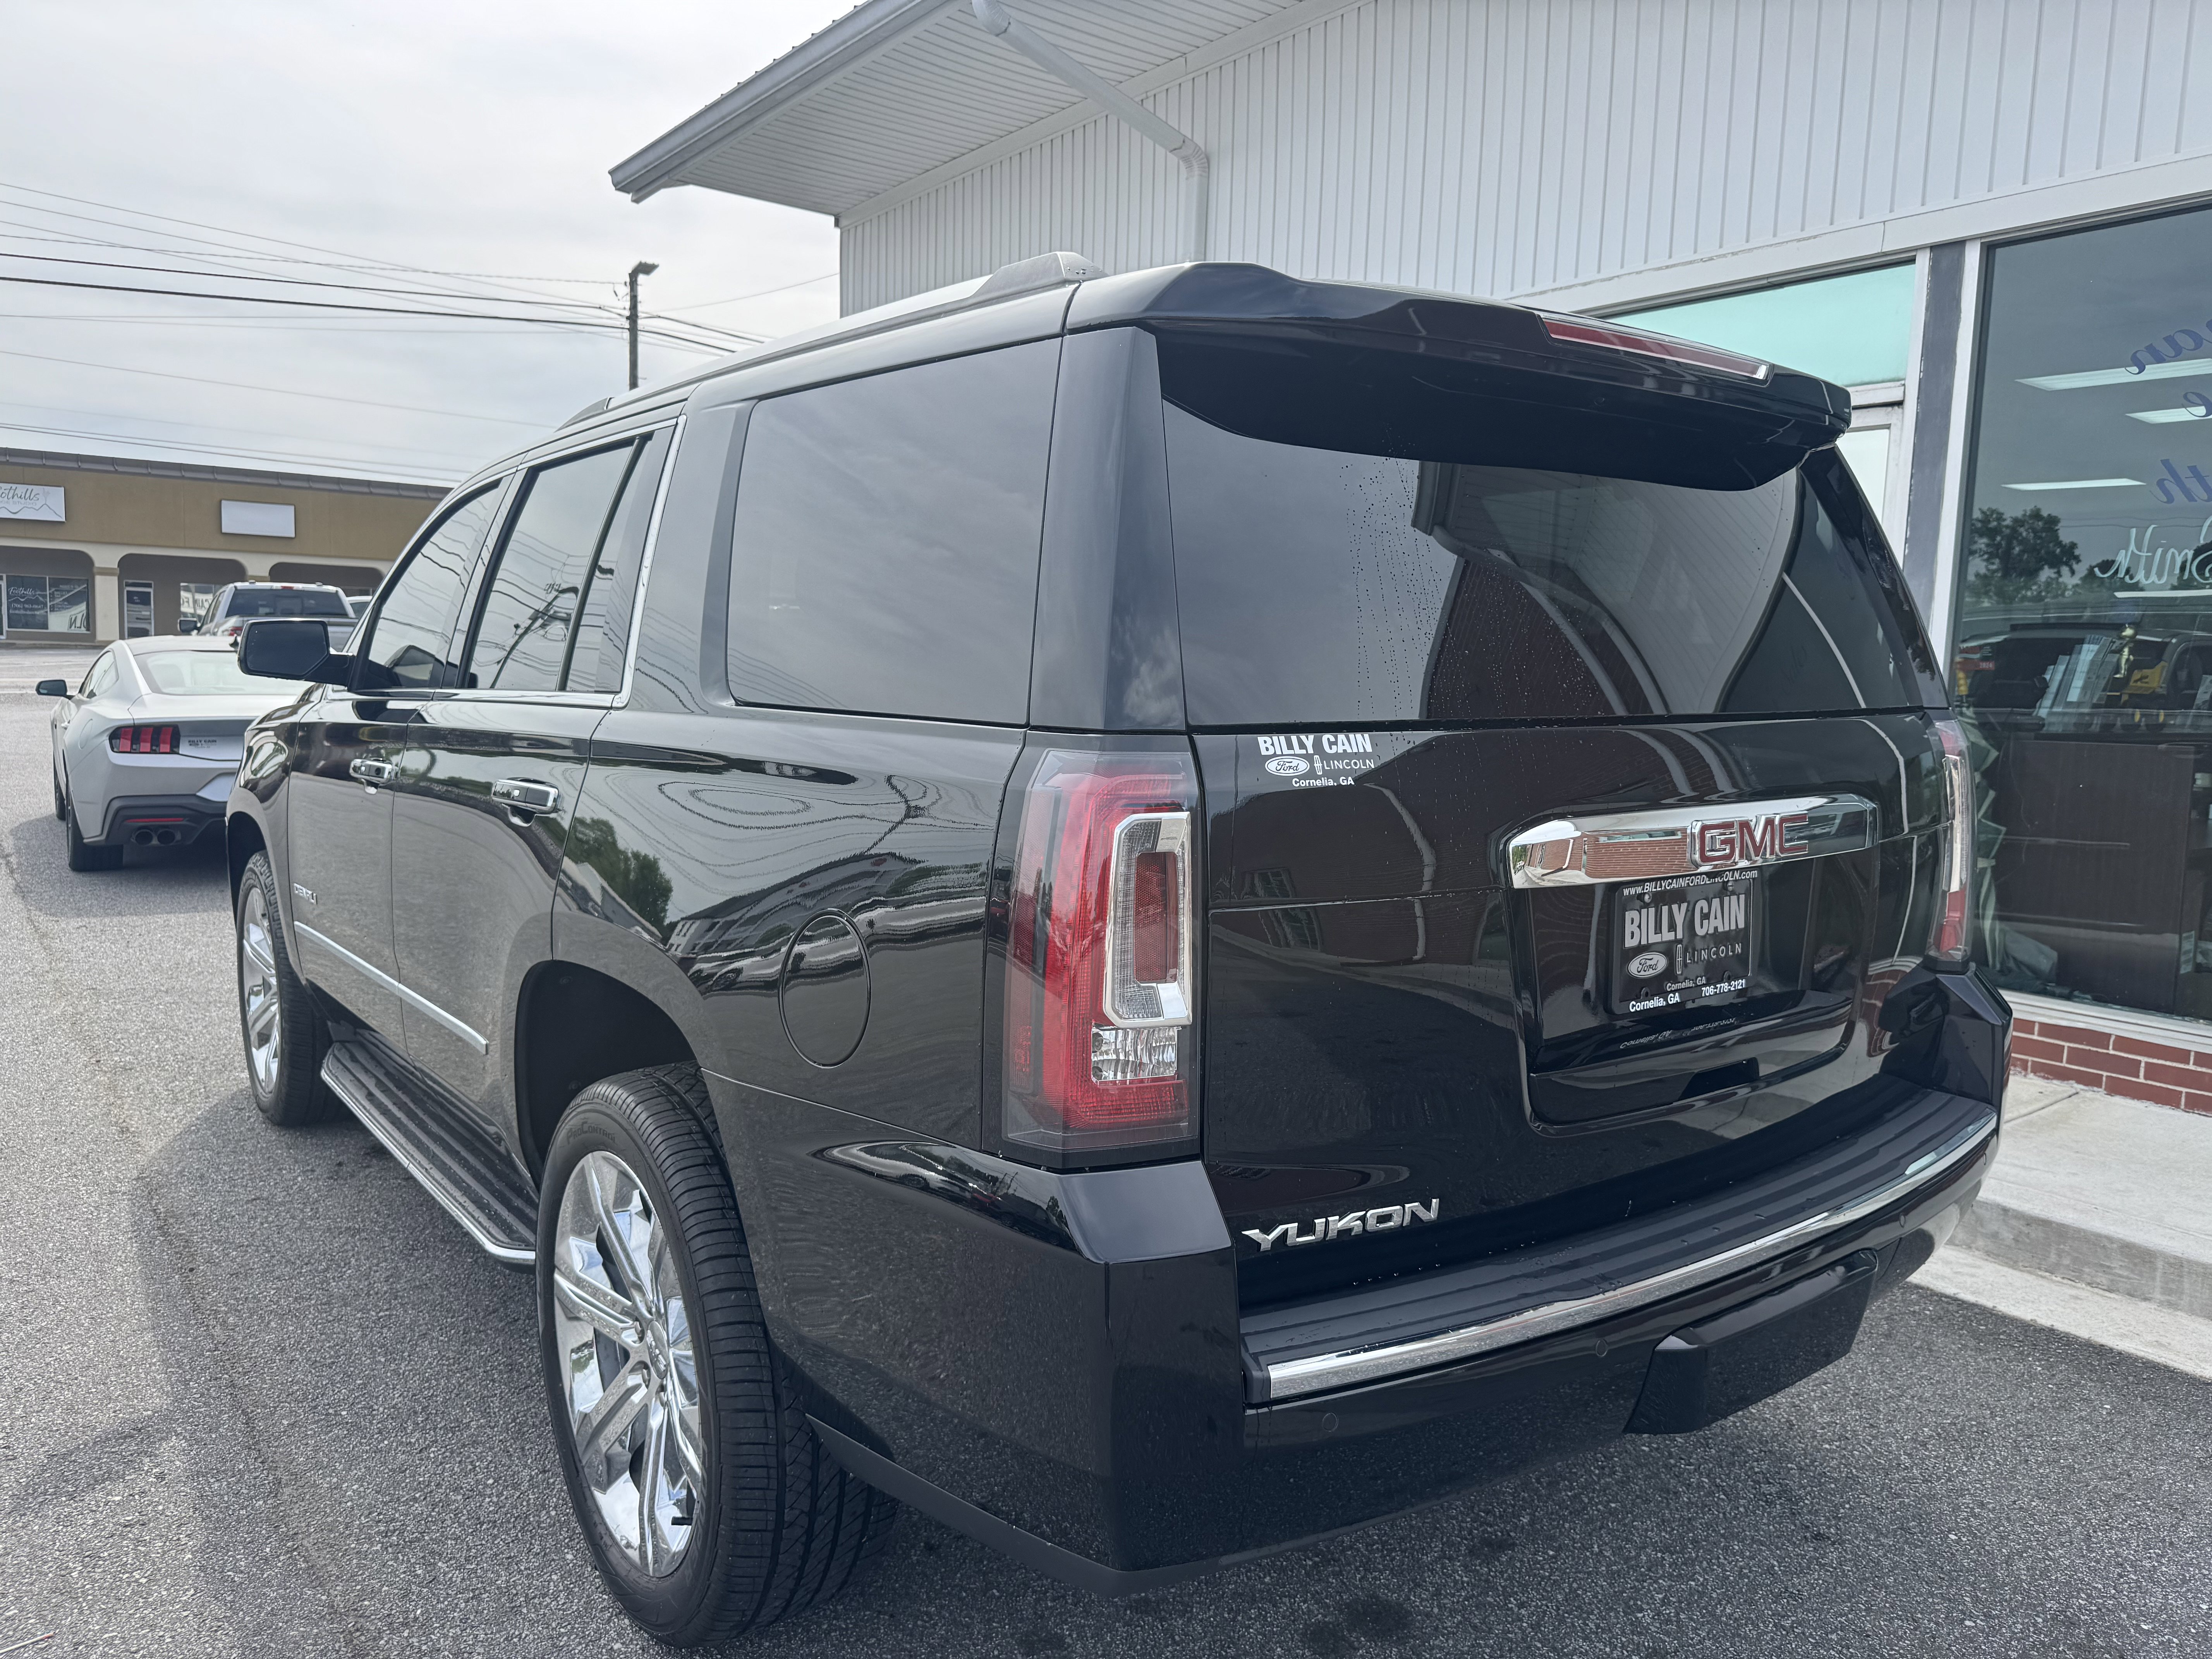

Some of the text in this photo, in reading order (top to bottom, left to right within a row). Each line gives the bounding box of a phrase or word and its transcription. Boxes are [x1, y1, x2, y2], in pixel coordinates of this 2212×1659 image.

[1257, 733, 1372, 755] BILLY CAIN
[1275, 761, 1299, 772] Ford
[1324, 759, 1374, 770] LINCOLN
[1340, 776, 1354, 785] GA
[1697, 811, 1808, 865] GMC
[1625, 894, 1745, 948] BILLY CAIN
[1686, 943, 1741, 963] LINCOLN
[1637, 957, 1658, 973] Ford
[1666, 976, 1706, 991] Cornelia, GA
[1702, 979, 1746, 997] 706-778-2121
[1629, 993, 1681, 1012] Cornelia, GA
[1241, 1198, 1439, 1252] YUKON
